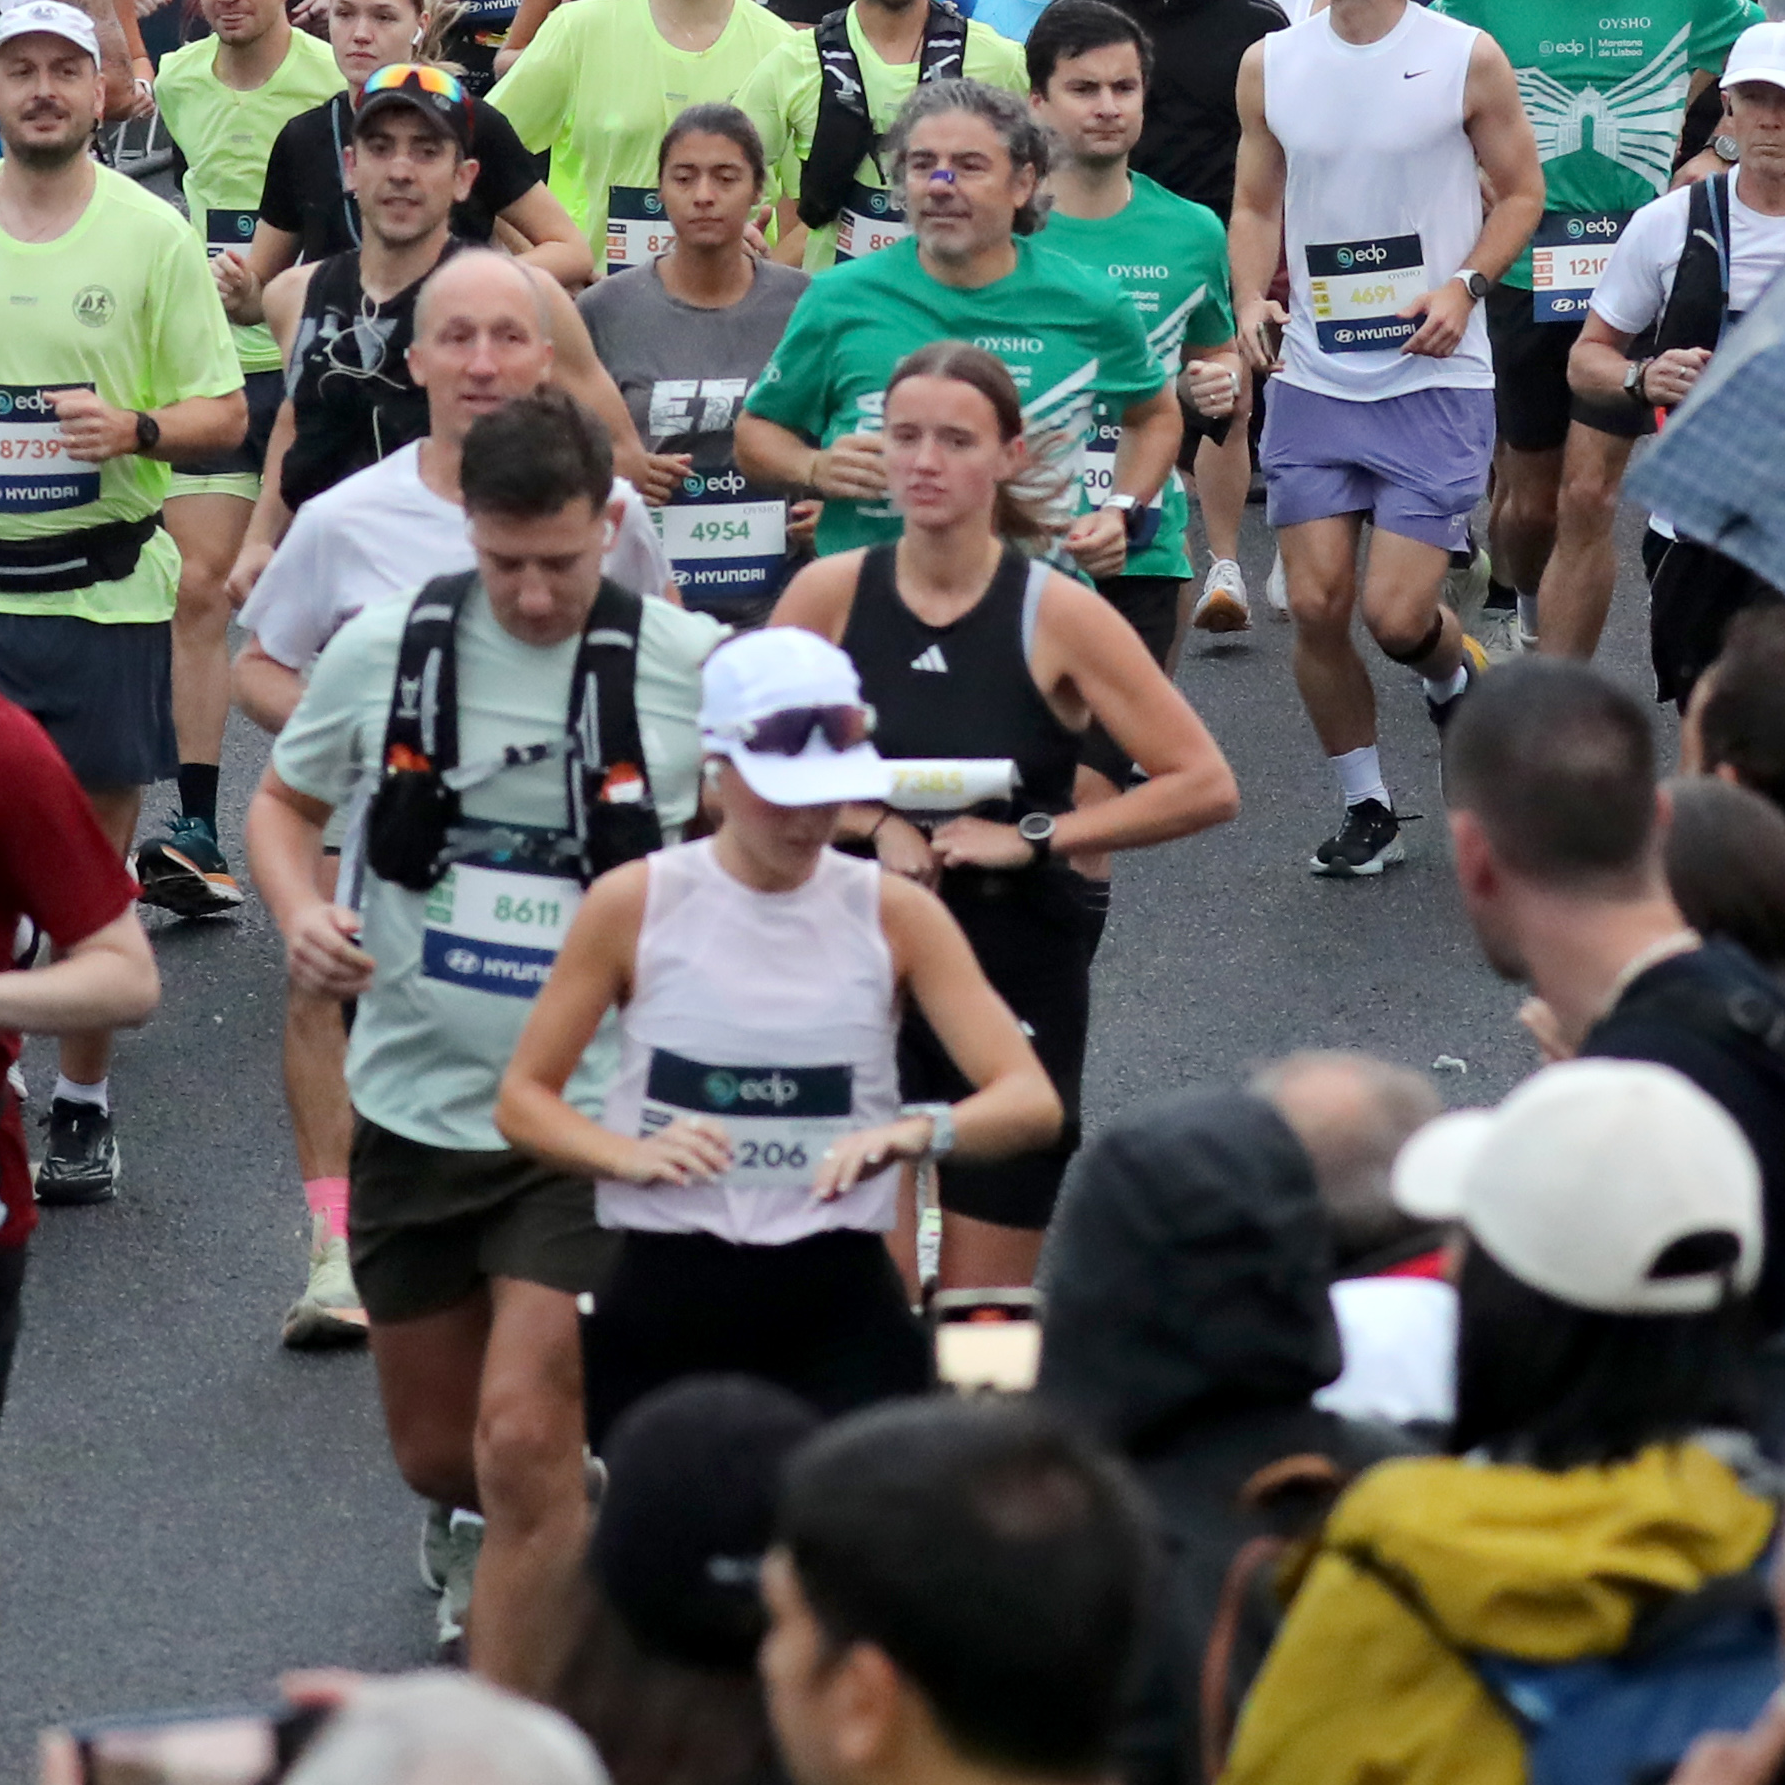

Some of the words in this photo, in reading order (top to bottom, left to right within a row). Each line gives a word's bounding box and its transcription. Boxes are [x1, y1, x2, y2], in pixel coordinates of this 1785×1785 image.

[1599, 18, 1651, 30] OYSHO
[1555, 39, 1585, 56] edp
[1586, 216, 1617, 237] edp
[1355, 244, 1388, 265] edp
[1108, 264, 1169, 280] OYSHO
[1350, 285, 1397, 305] 4691
[1357, 323, 1417, 341] HYUNDAI
[974, 336, 1045, 353] OYSHO
[0, 439, 61, 460] 8739
[706, 471, 746, 495] edp
[6, 486, 79, 501] HYUNDAI
[690, 521, 751, 542] 4954
[695, 568, 766, 584] HYUNDAI
[494, 893, 561, 927] 8611
[739, 1071, 799, 1108] edp
